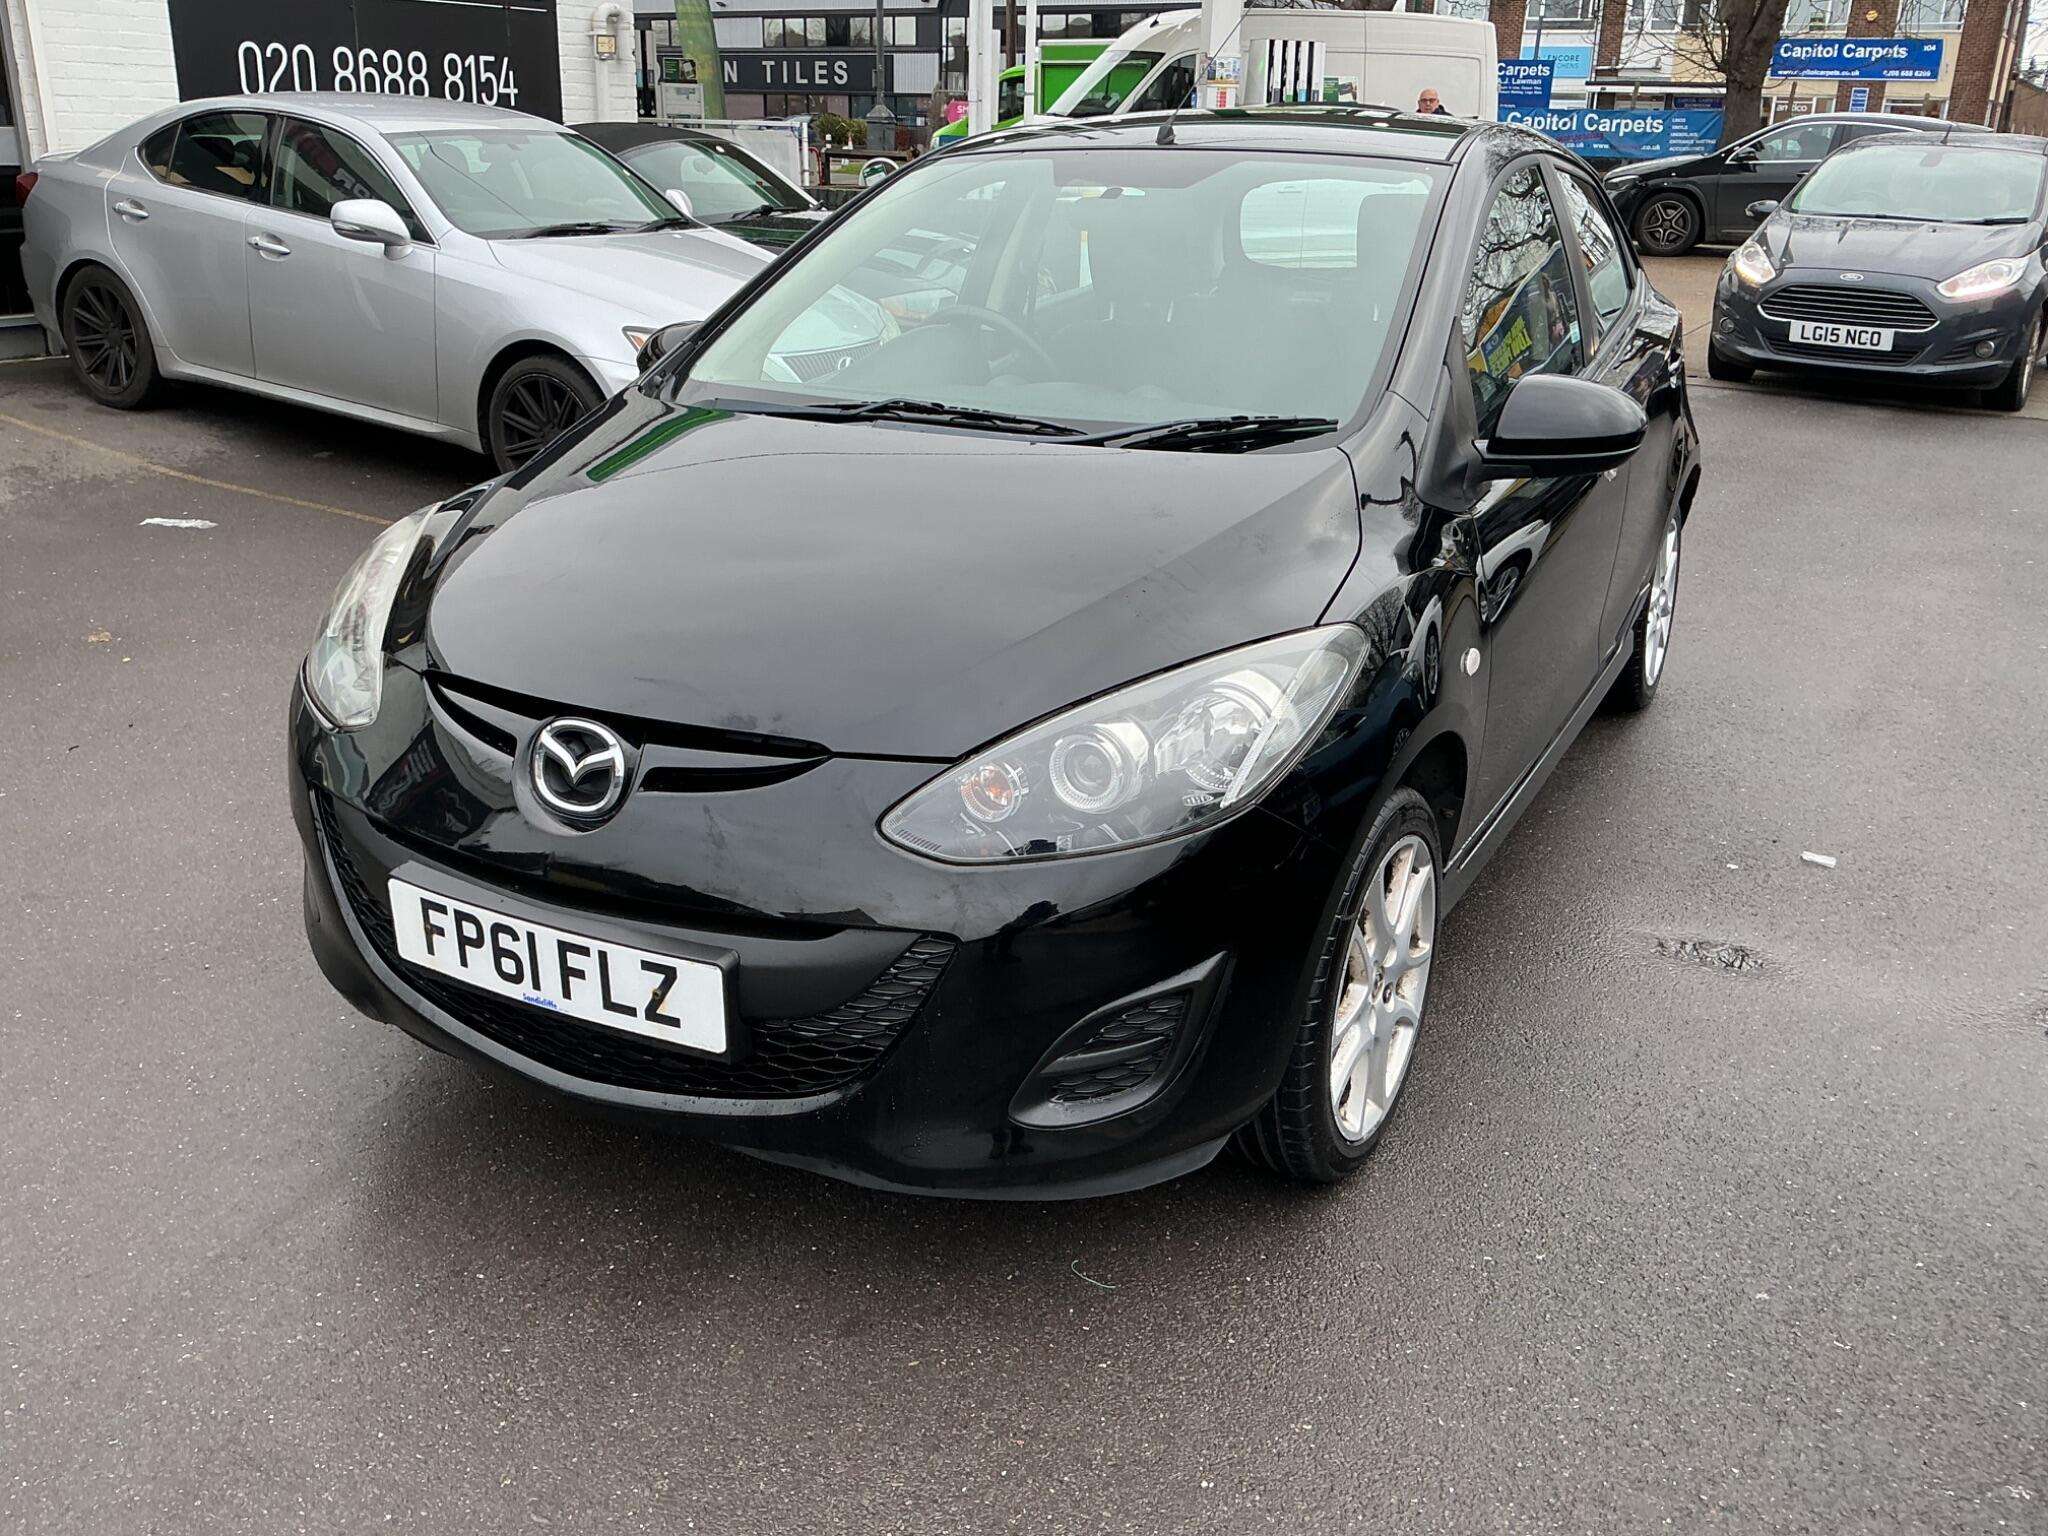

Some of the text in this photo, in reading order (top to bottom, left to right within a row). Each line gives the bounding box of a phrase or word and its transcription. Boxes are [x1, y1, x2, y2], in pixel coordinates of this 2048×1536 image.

[1780, 43, 1909, 61] Capitol Carpets
[238, 41, 518, 106] 020 8688 8154
[762, 60, 848, 85] TILES
[1497, 63, 1550, 78] Carpets
[1506, 112, 1664, 136] Capitol Carpets
[1800, 324, 1882, 347] LG15 NCO
[420, 897, 682, 1029] FP61 FLZ
